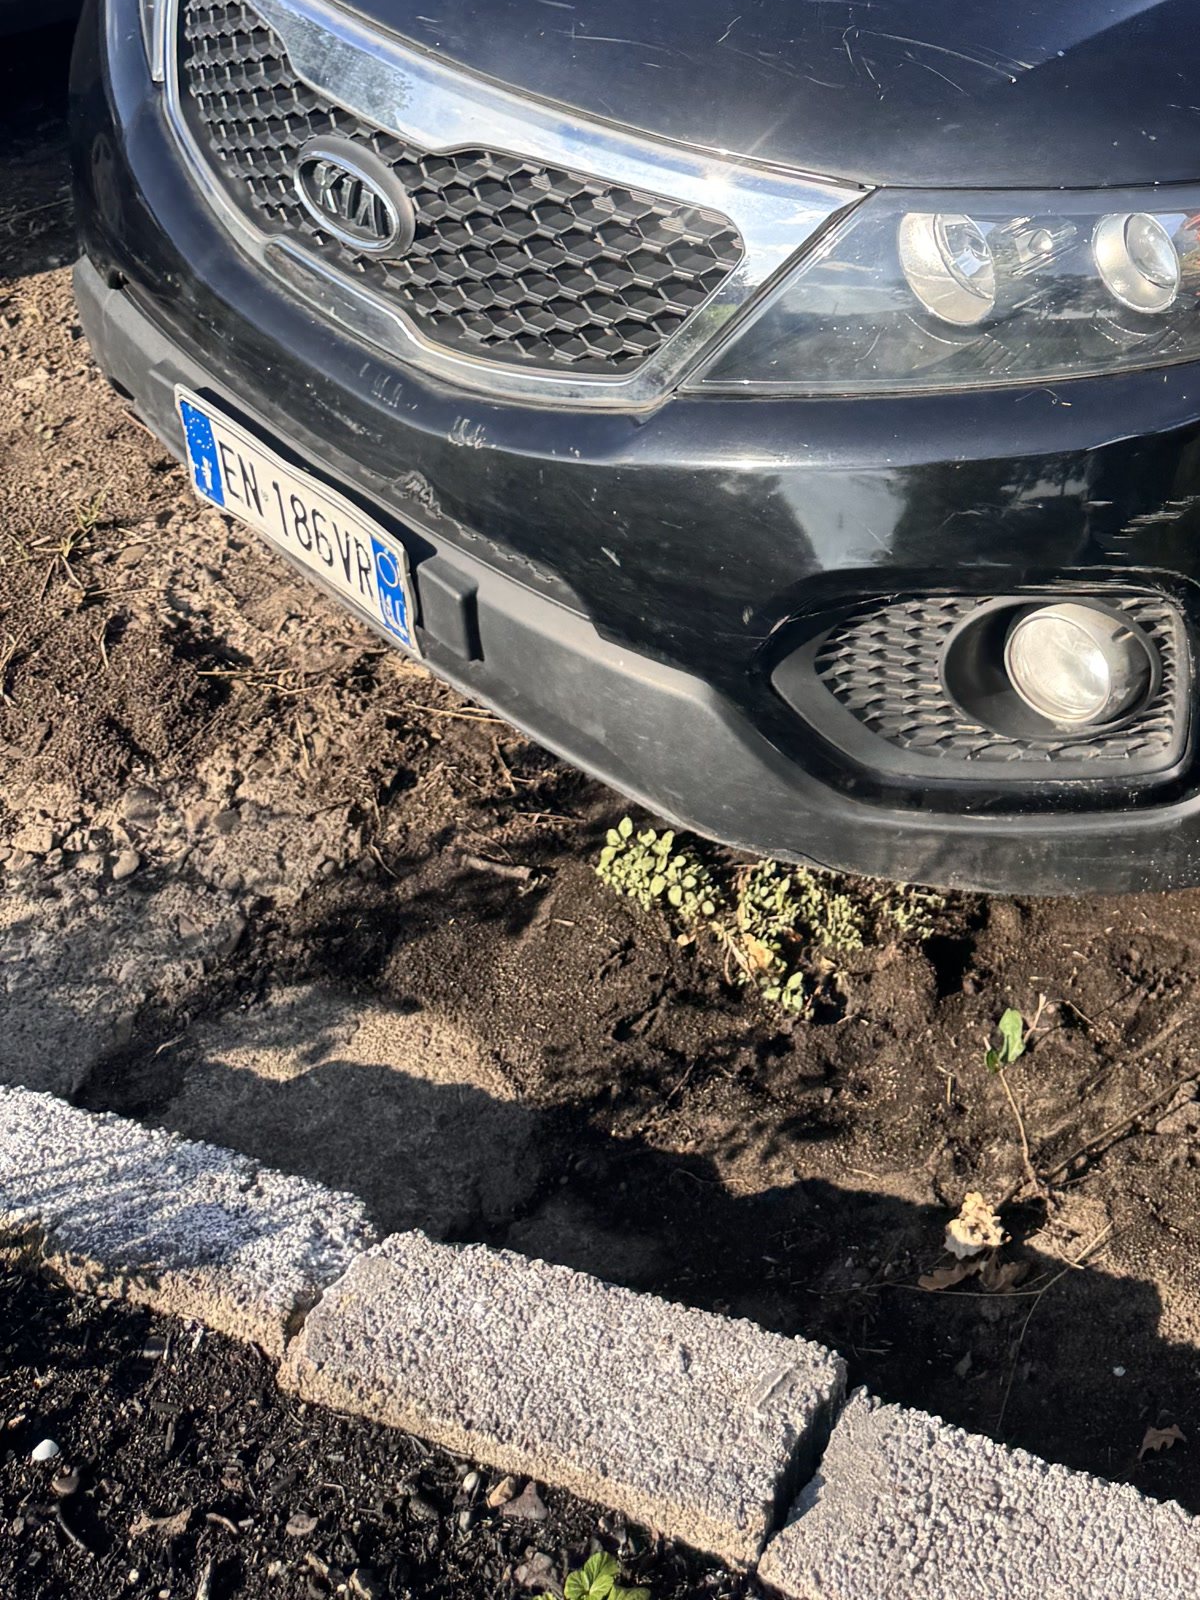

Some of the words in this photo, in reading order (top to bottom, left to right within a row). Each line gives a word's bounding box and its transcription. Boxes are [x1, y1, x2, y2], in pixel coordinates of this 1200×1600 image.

[313, 160, 387, 239] KIA
[218, 439, 264, 518] EN
[272, 479, 374, 599] 186VR
